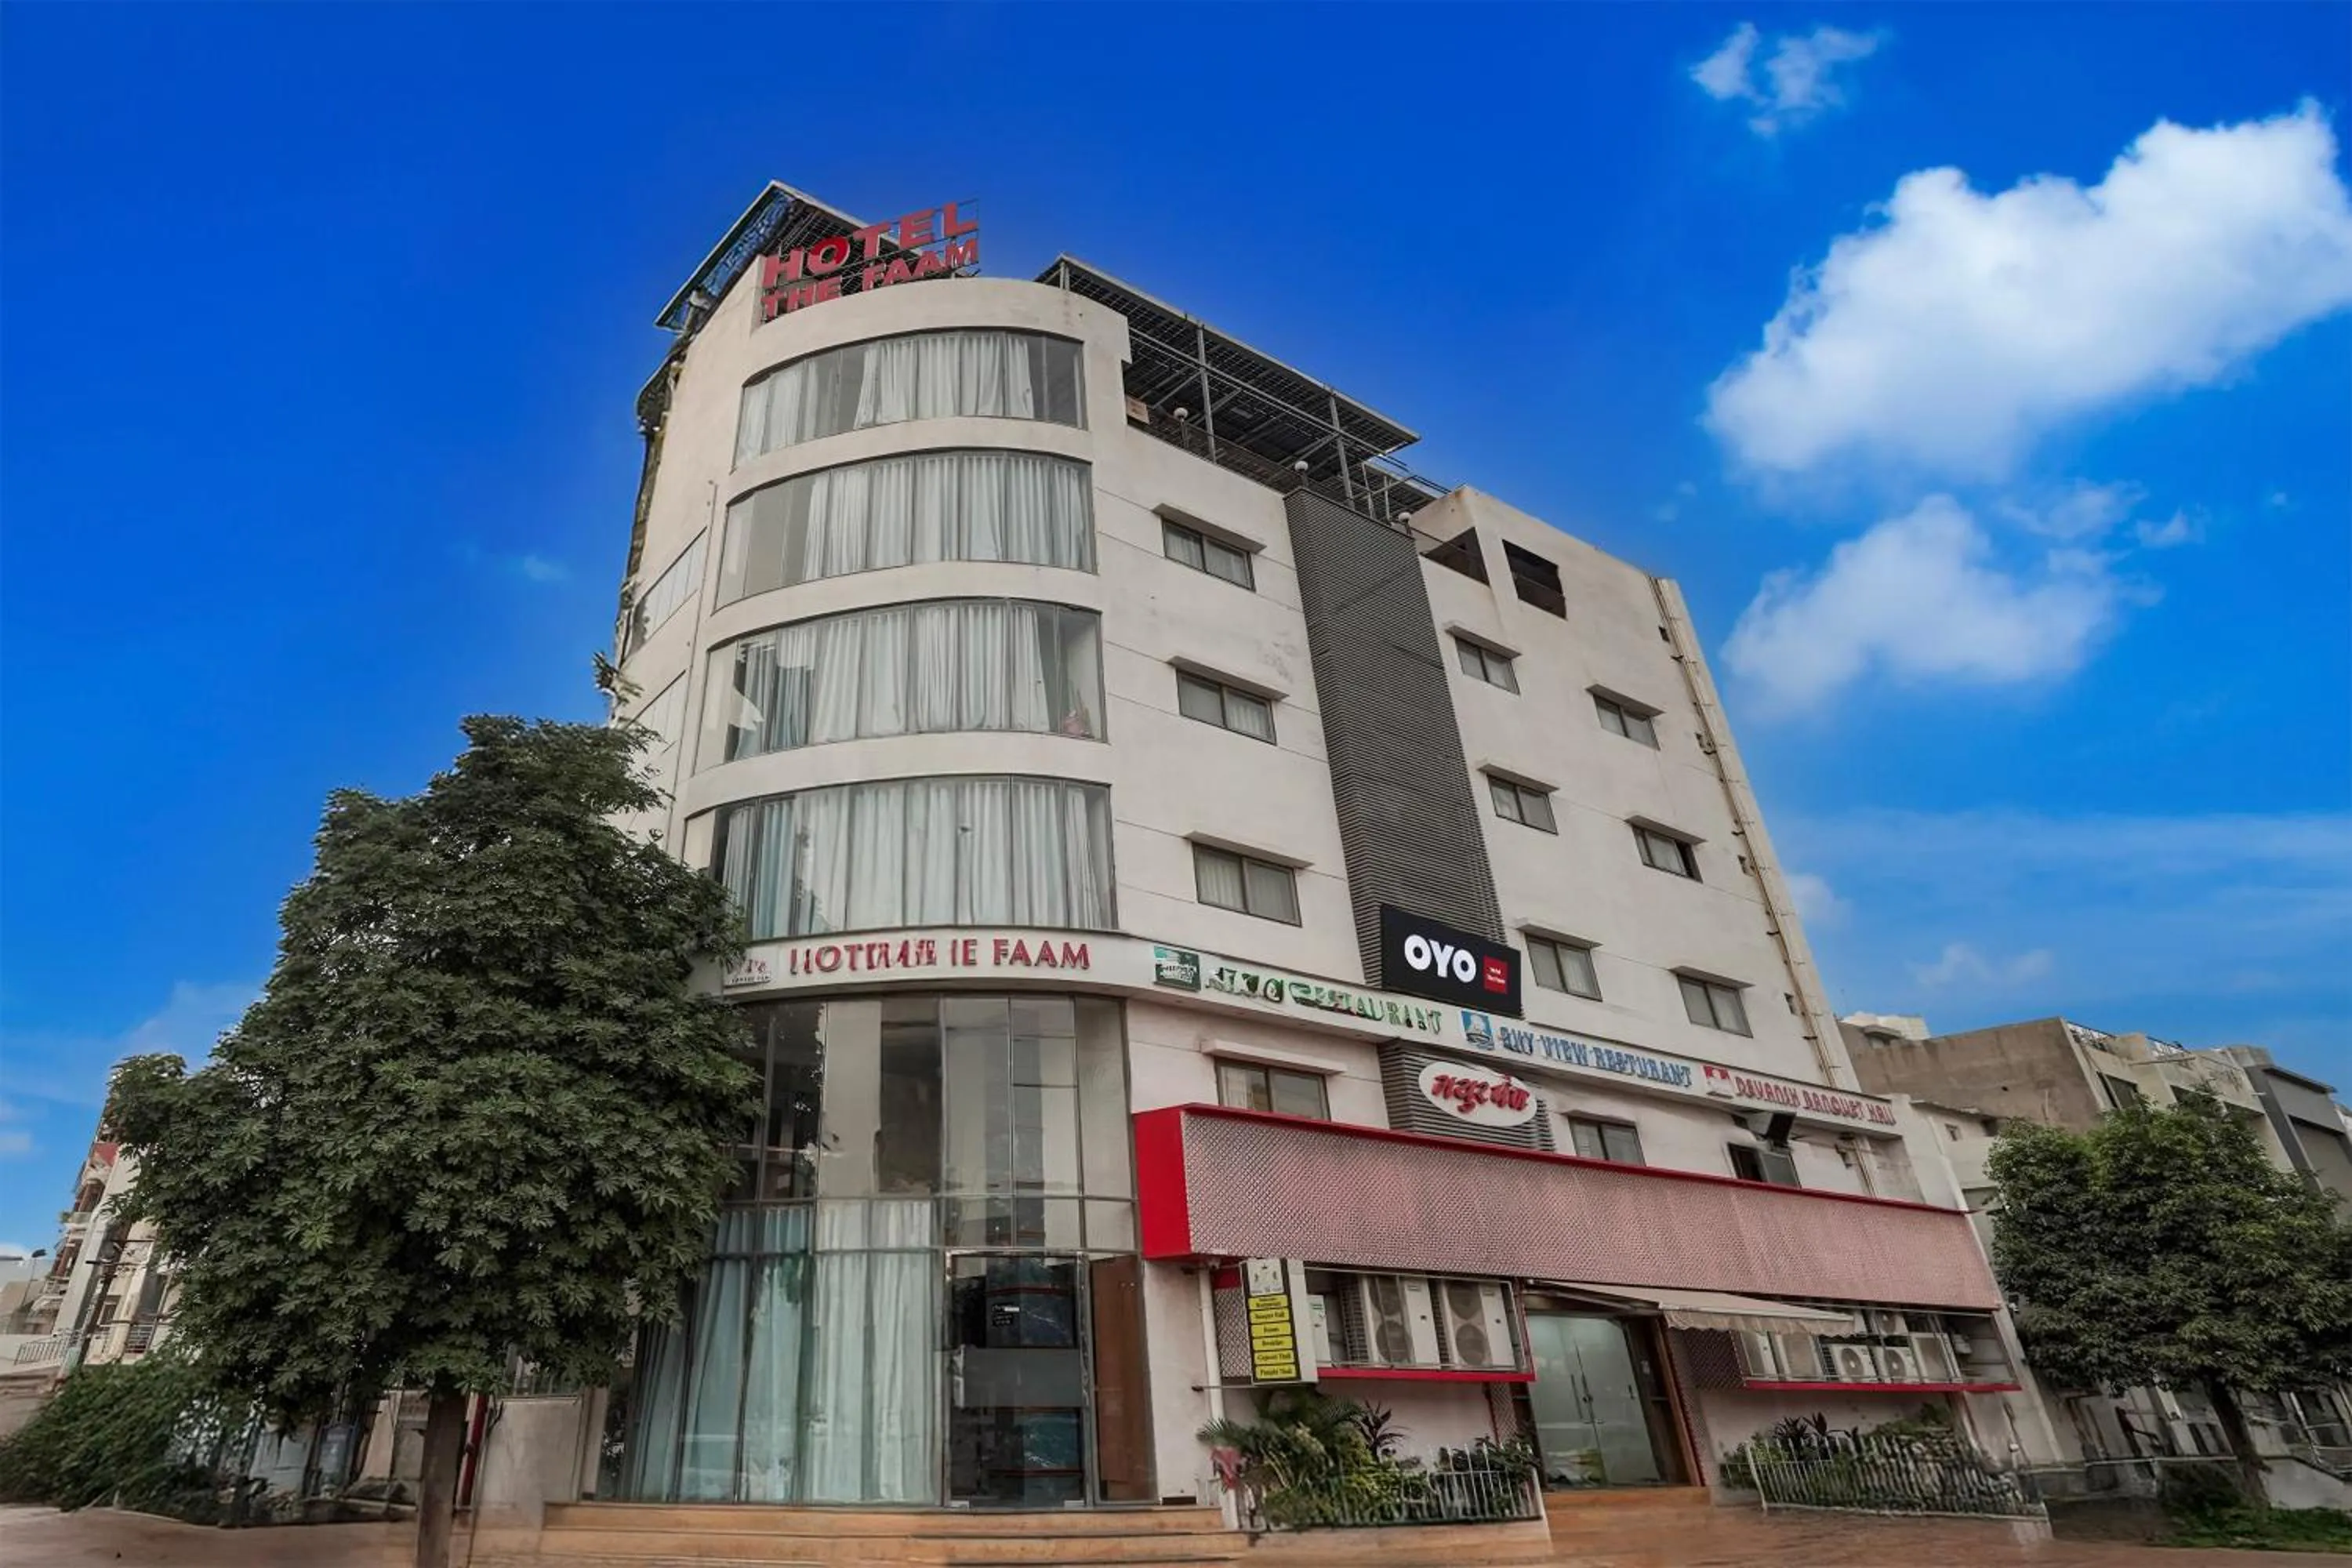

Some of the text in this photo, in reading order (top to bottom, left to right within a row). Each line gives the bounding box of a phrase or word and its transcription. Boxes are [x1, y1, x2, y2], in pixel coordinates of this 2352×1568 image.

[761, 201, 978, 289] HOTEL
[760, 238, 978, 320] THE FAAM
[993, 939, 1091, 970] FAAM
[1404, 934, 1476, 983] OYO
